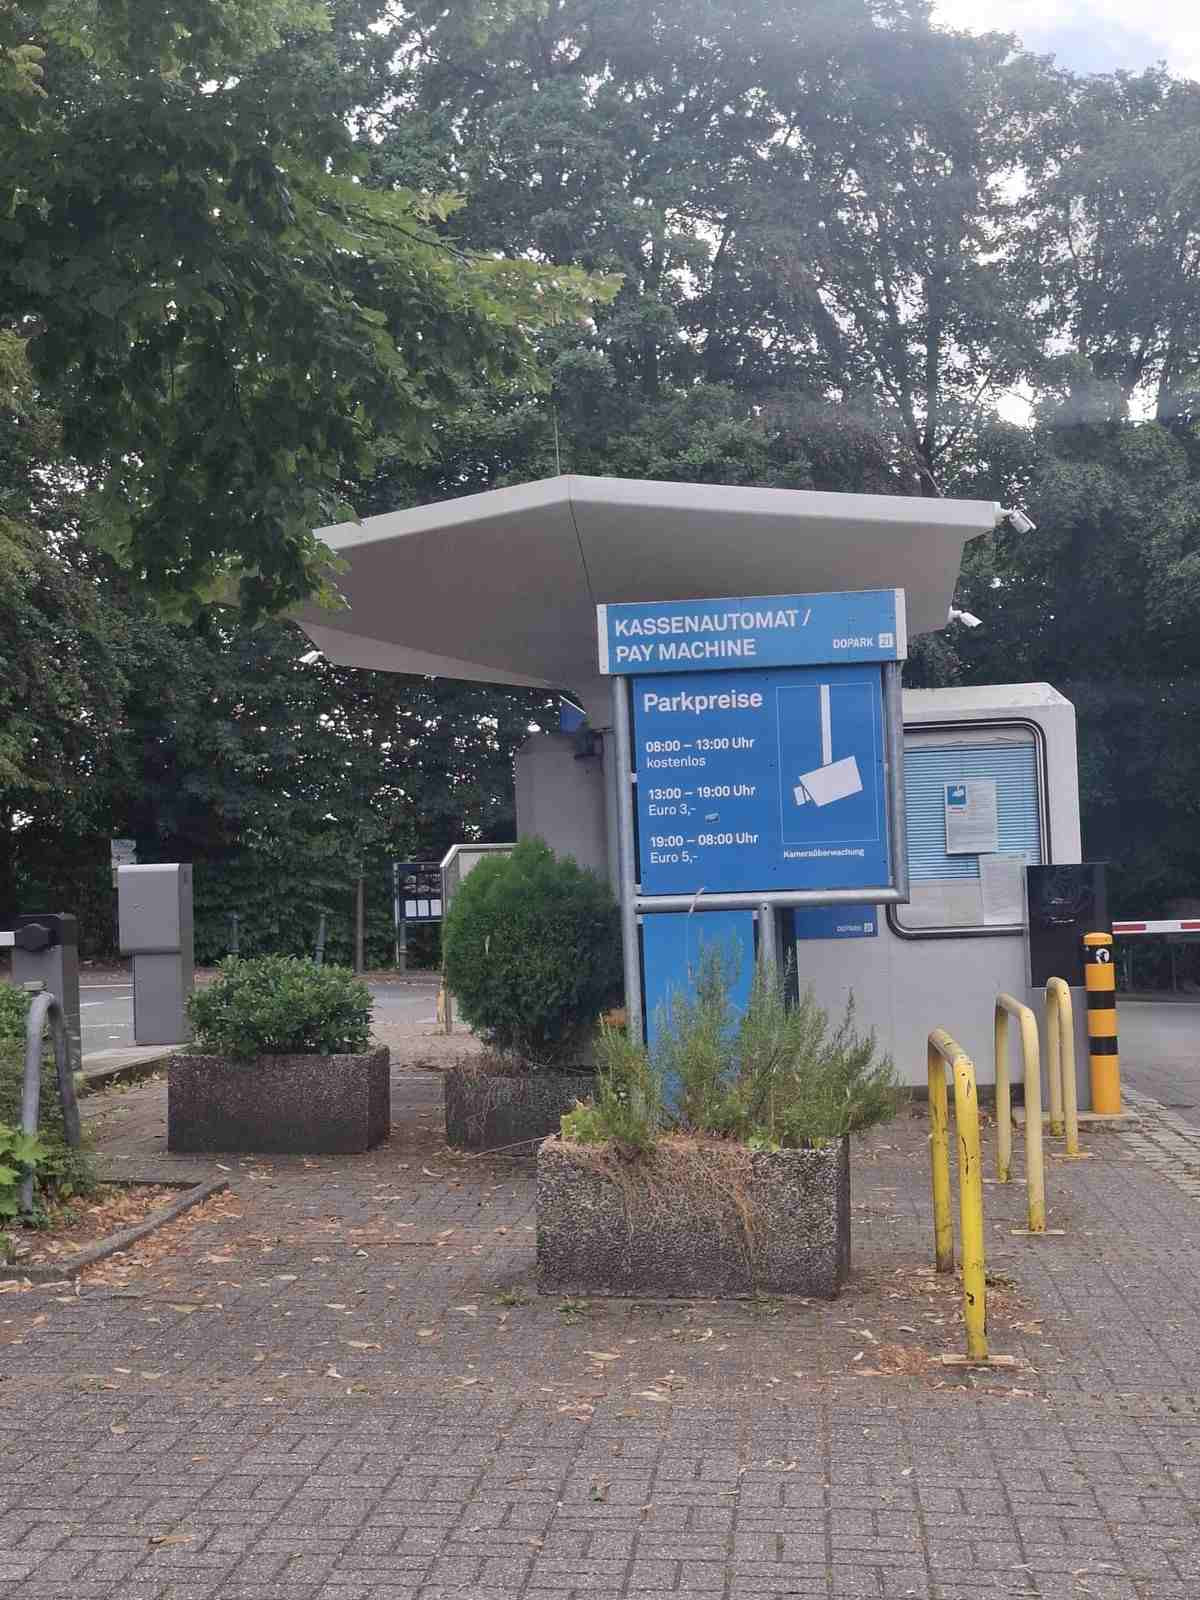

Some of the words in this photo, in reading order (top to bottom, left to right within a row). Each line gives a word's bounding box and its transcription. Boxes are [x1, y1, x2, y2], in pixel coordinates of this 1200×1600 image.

[615, 609, 799, 637] KASSENAUTOMAT
[802, 608, 812, 627] /
[616, 644, 654, 663] PAY
[658, 638, 757, 661] MACHINE
[832, 637, 873, 649] DOPARK
[643, 689, 763, 715] Parkpreise
[645, 740, 681, 753] 08:00
[696, 738, 730, 751] 13:00
[732, 735, 755, 749] Uhr
[647, 755, 706, 769] kostenlos
[648, 788, 682, 801] 13:00
[697, 785, 731, 798] 19:00
[733, 784, 756, 797] Uhr
[648, 804, 677, 817] Euro
[650, 835, 684, 848] 19:00
[698, 833, 733, 847] 08:00
[735, 832, 760, 845] Uhr
[650, 851, 679, 865] Euro
[783, 847, 865, 859] Kameraüberwachung
